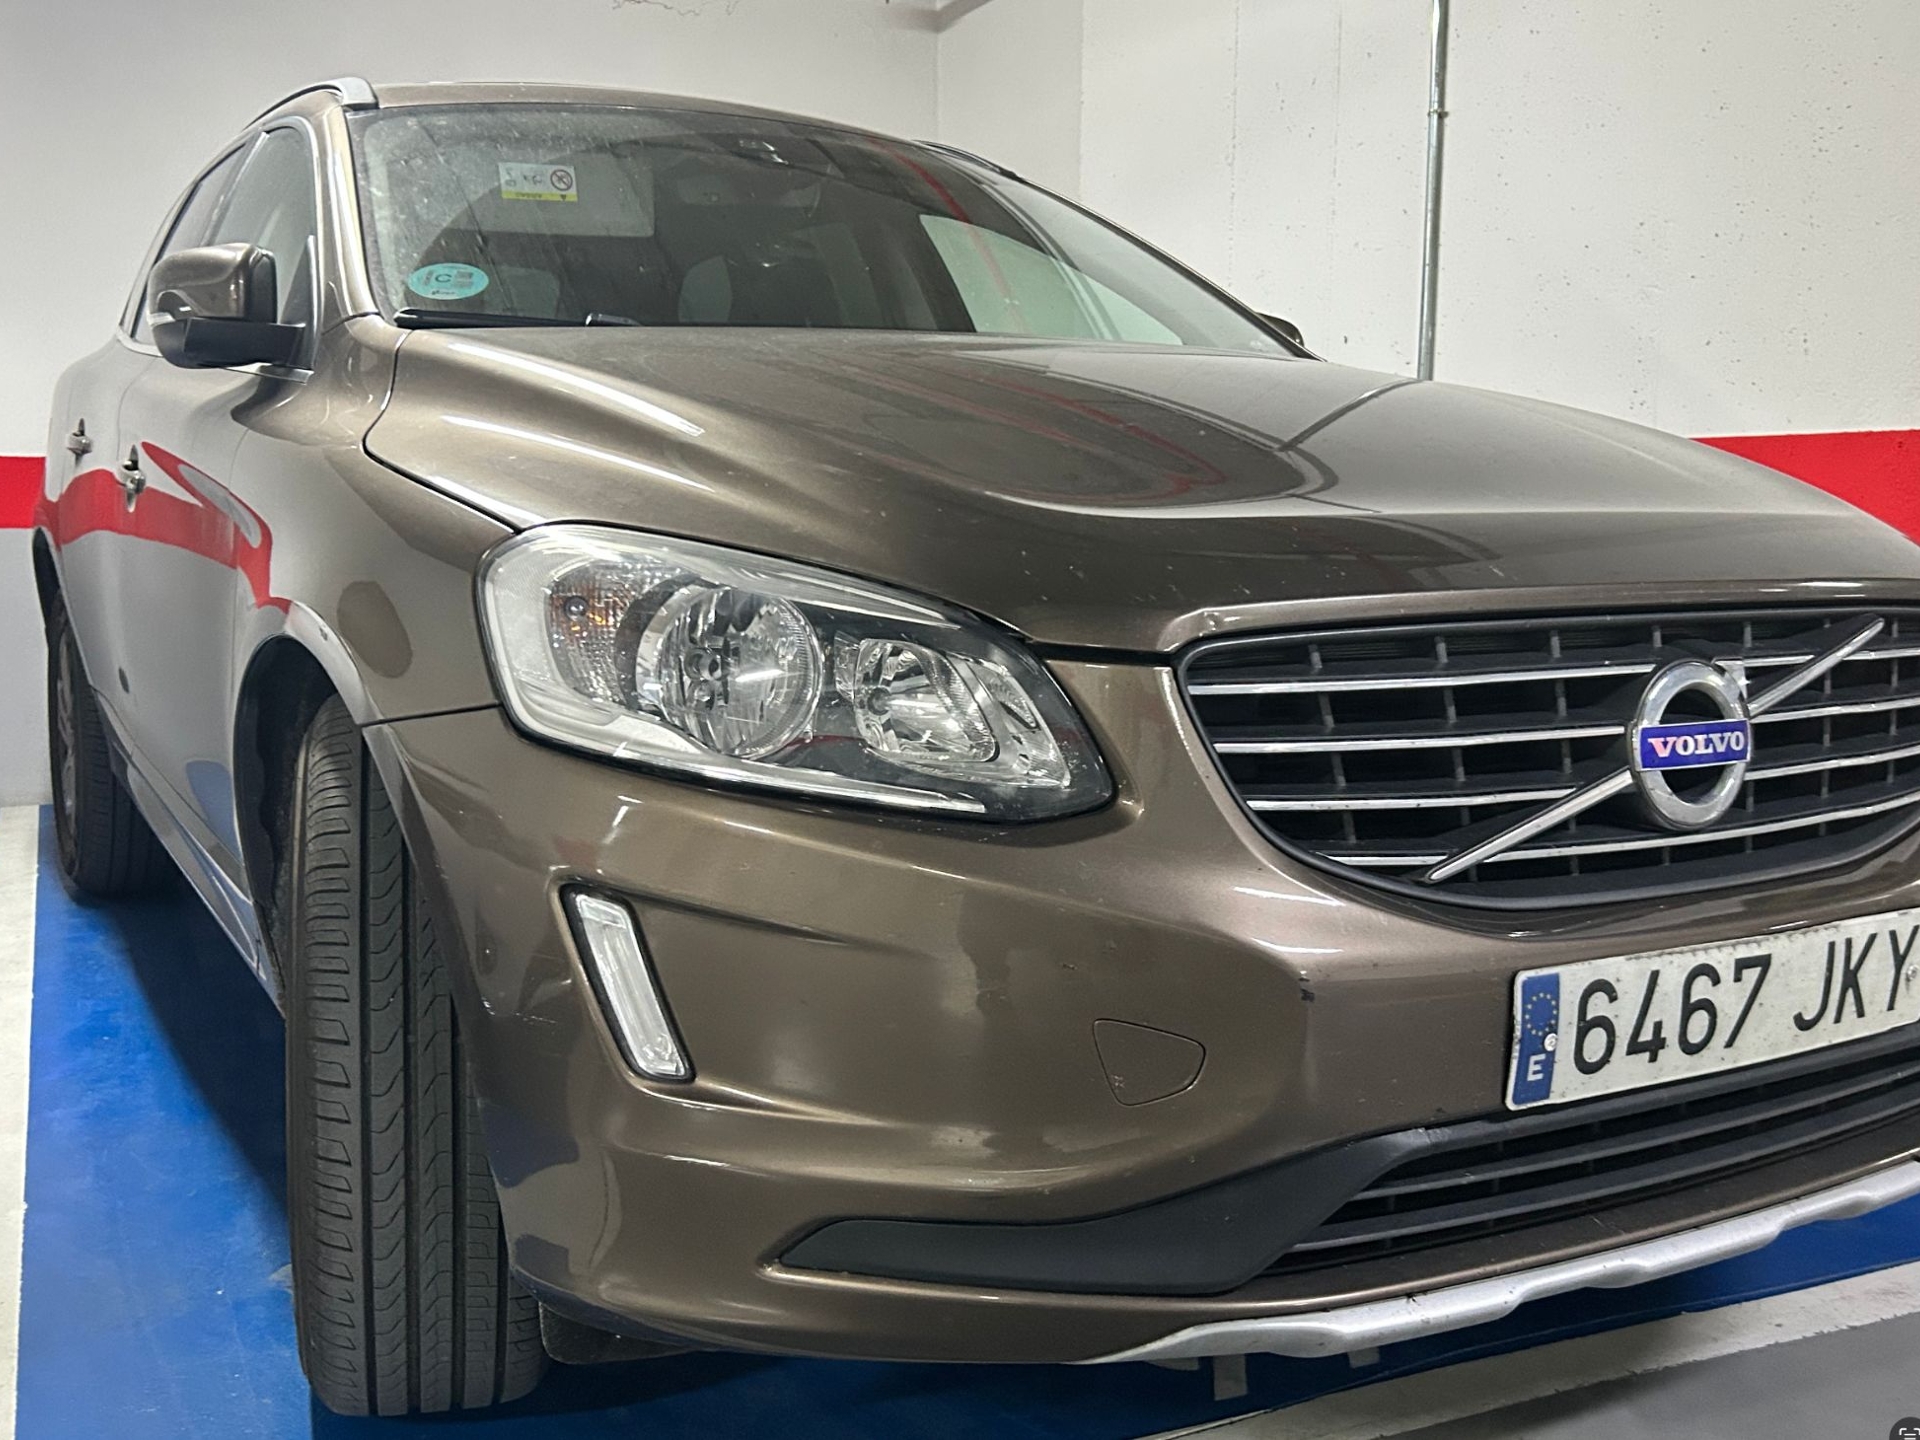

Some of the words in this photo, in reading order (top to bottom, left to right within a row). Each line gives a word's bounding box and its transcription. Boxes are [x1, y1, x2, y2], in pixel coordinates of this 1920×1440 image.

[1647, 731, 1745, 758] VOLVO
[1573, 953, 1772, 1075] 6467
[1793, 924, 1920, 1032] JKY
[1526, 1053, 1546, 1082] E
